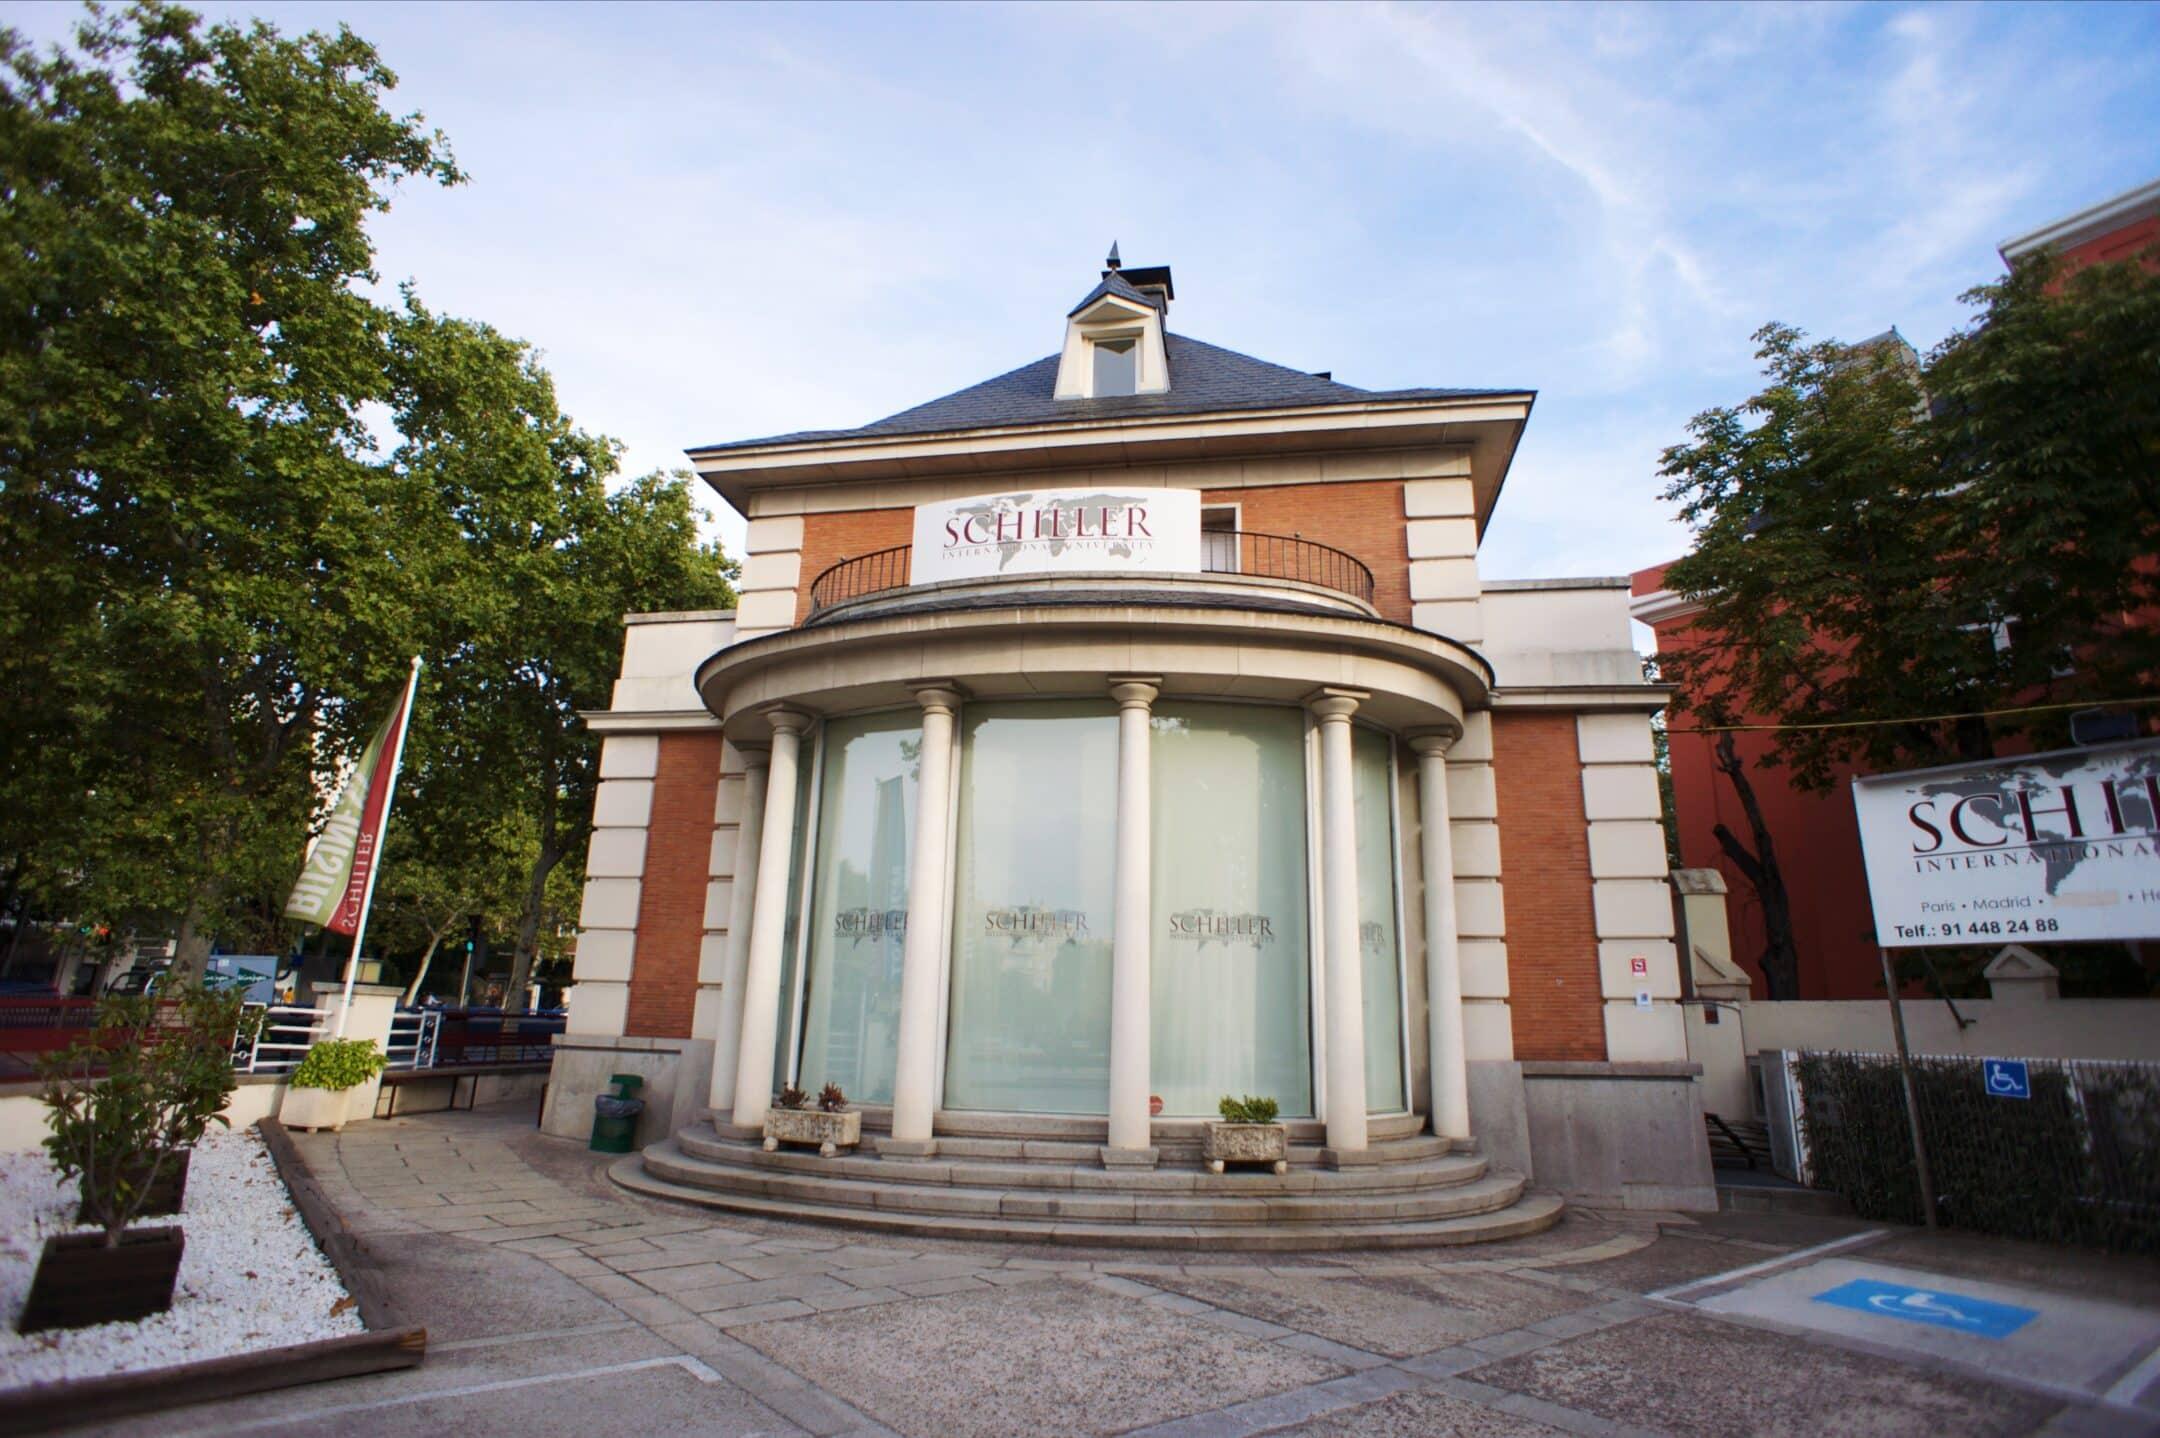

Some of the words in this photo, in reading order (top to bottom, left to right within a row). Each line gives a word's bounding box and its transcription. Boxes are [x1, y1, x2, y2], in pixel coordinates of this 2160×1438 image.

[943, 506, 1152, 548] SCHILLER
[1921, 901, 1956, 913] Paris
[1973, 896, 2032, 910] Madrid
[1169, 915, 1273, 936] SCHILLER
[1895, 922, 1936, 938] Telf.:
[1941, 922, 1962, 936] 91
[1968, 920, 2001, 935] 448
[2006, 919, 2030, 934] 24
[2035, 918, 2059, 933] 88
